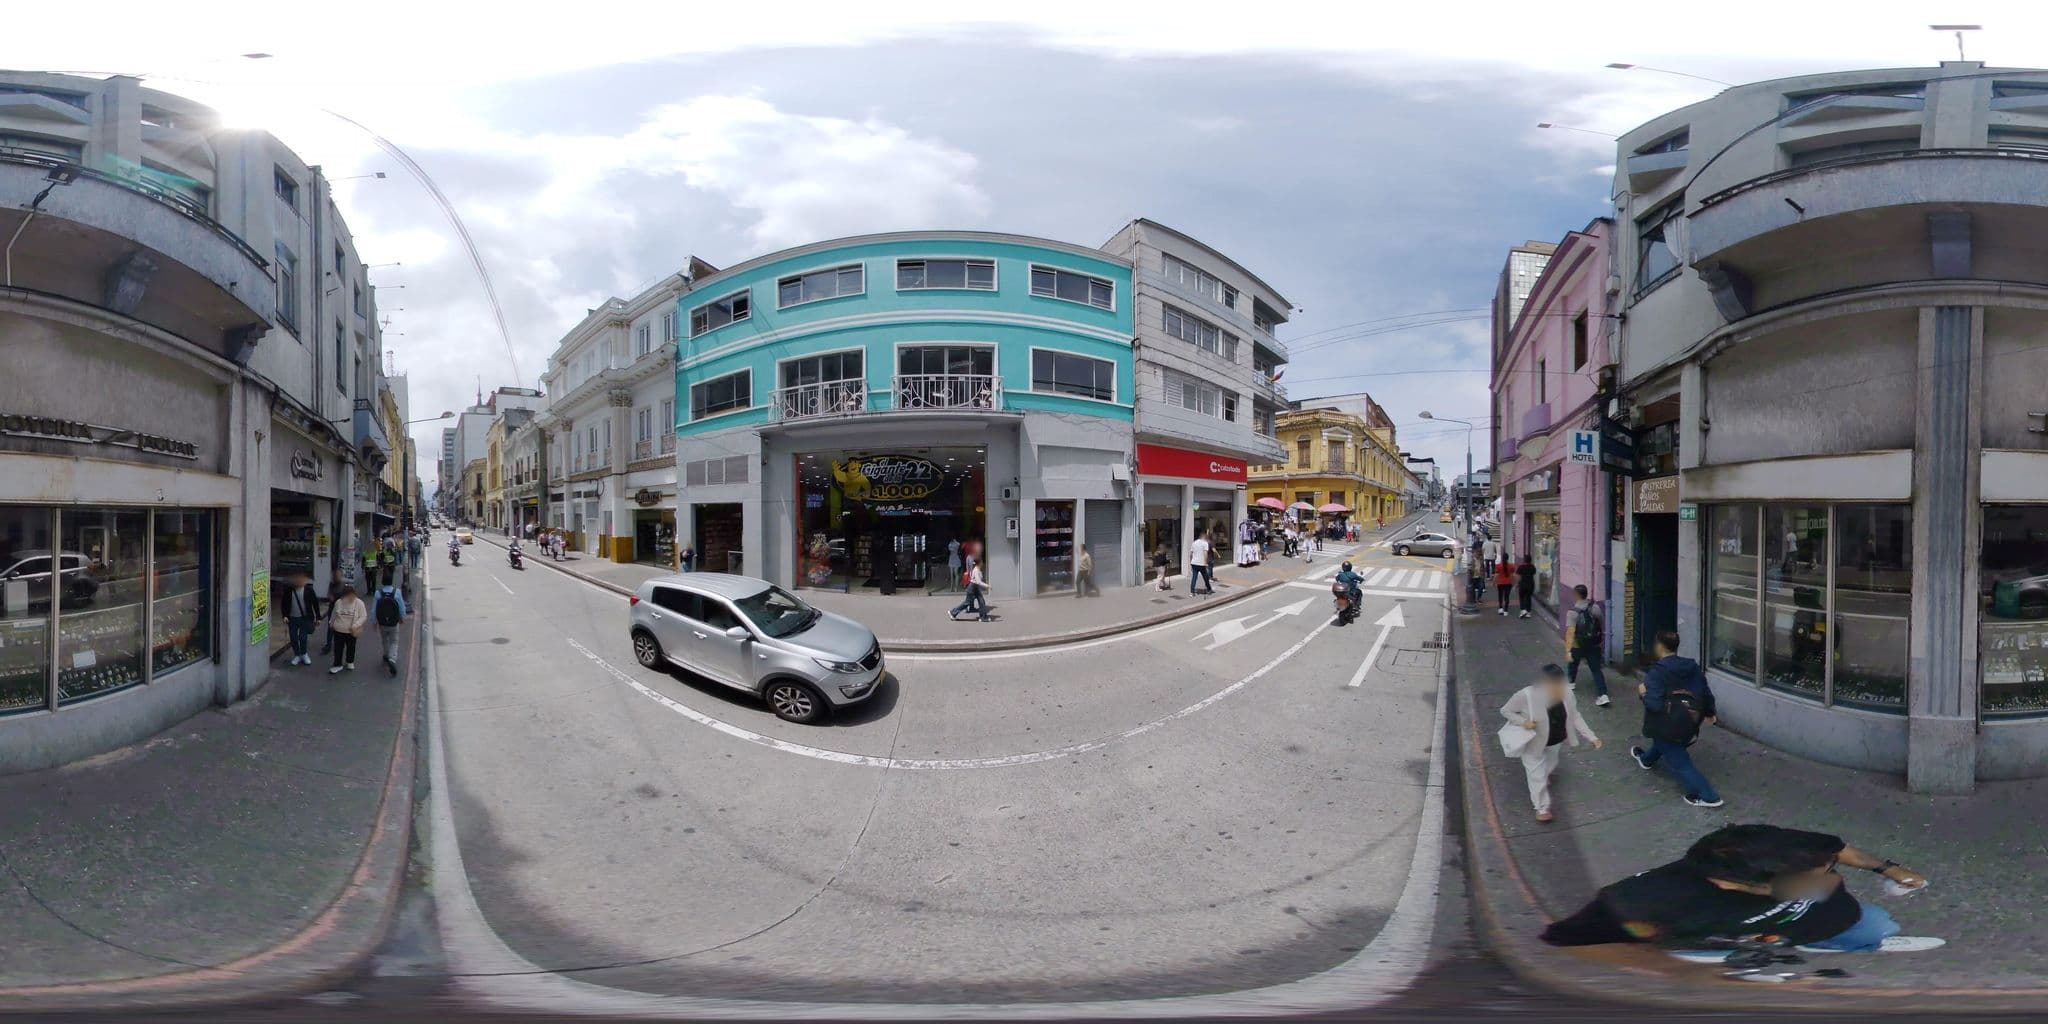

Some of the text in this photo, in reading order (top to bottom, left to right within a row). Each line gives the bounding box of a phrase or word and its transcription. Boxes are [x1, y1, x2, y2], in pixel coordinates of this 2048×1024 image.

[137, 432, 195, 456] JAGUAR
[1576, 432, 1592, 454] H
[1572, 454, 1596, 462] HOTEL
[861, 460, 932, 479] Gigante 22
